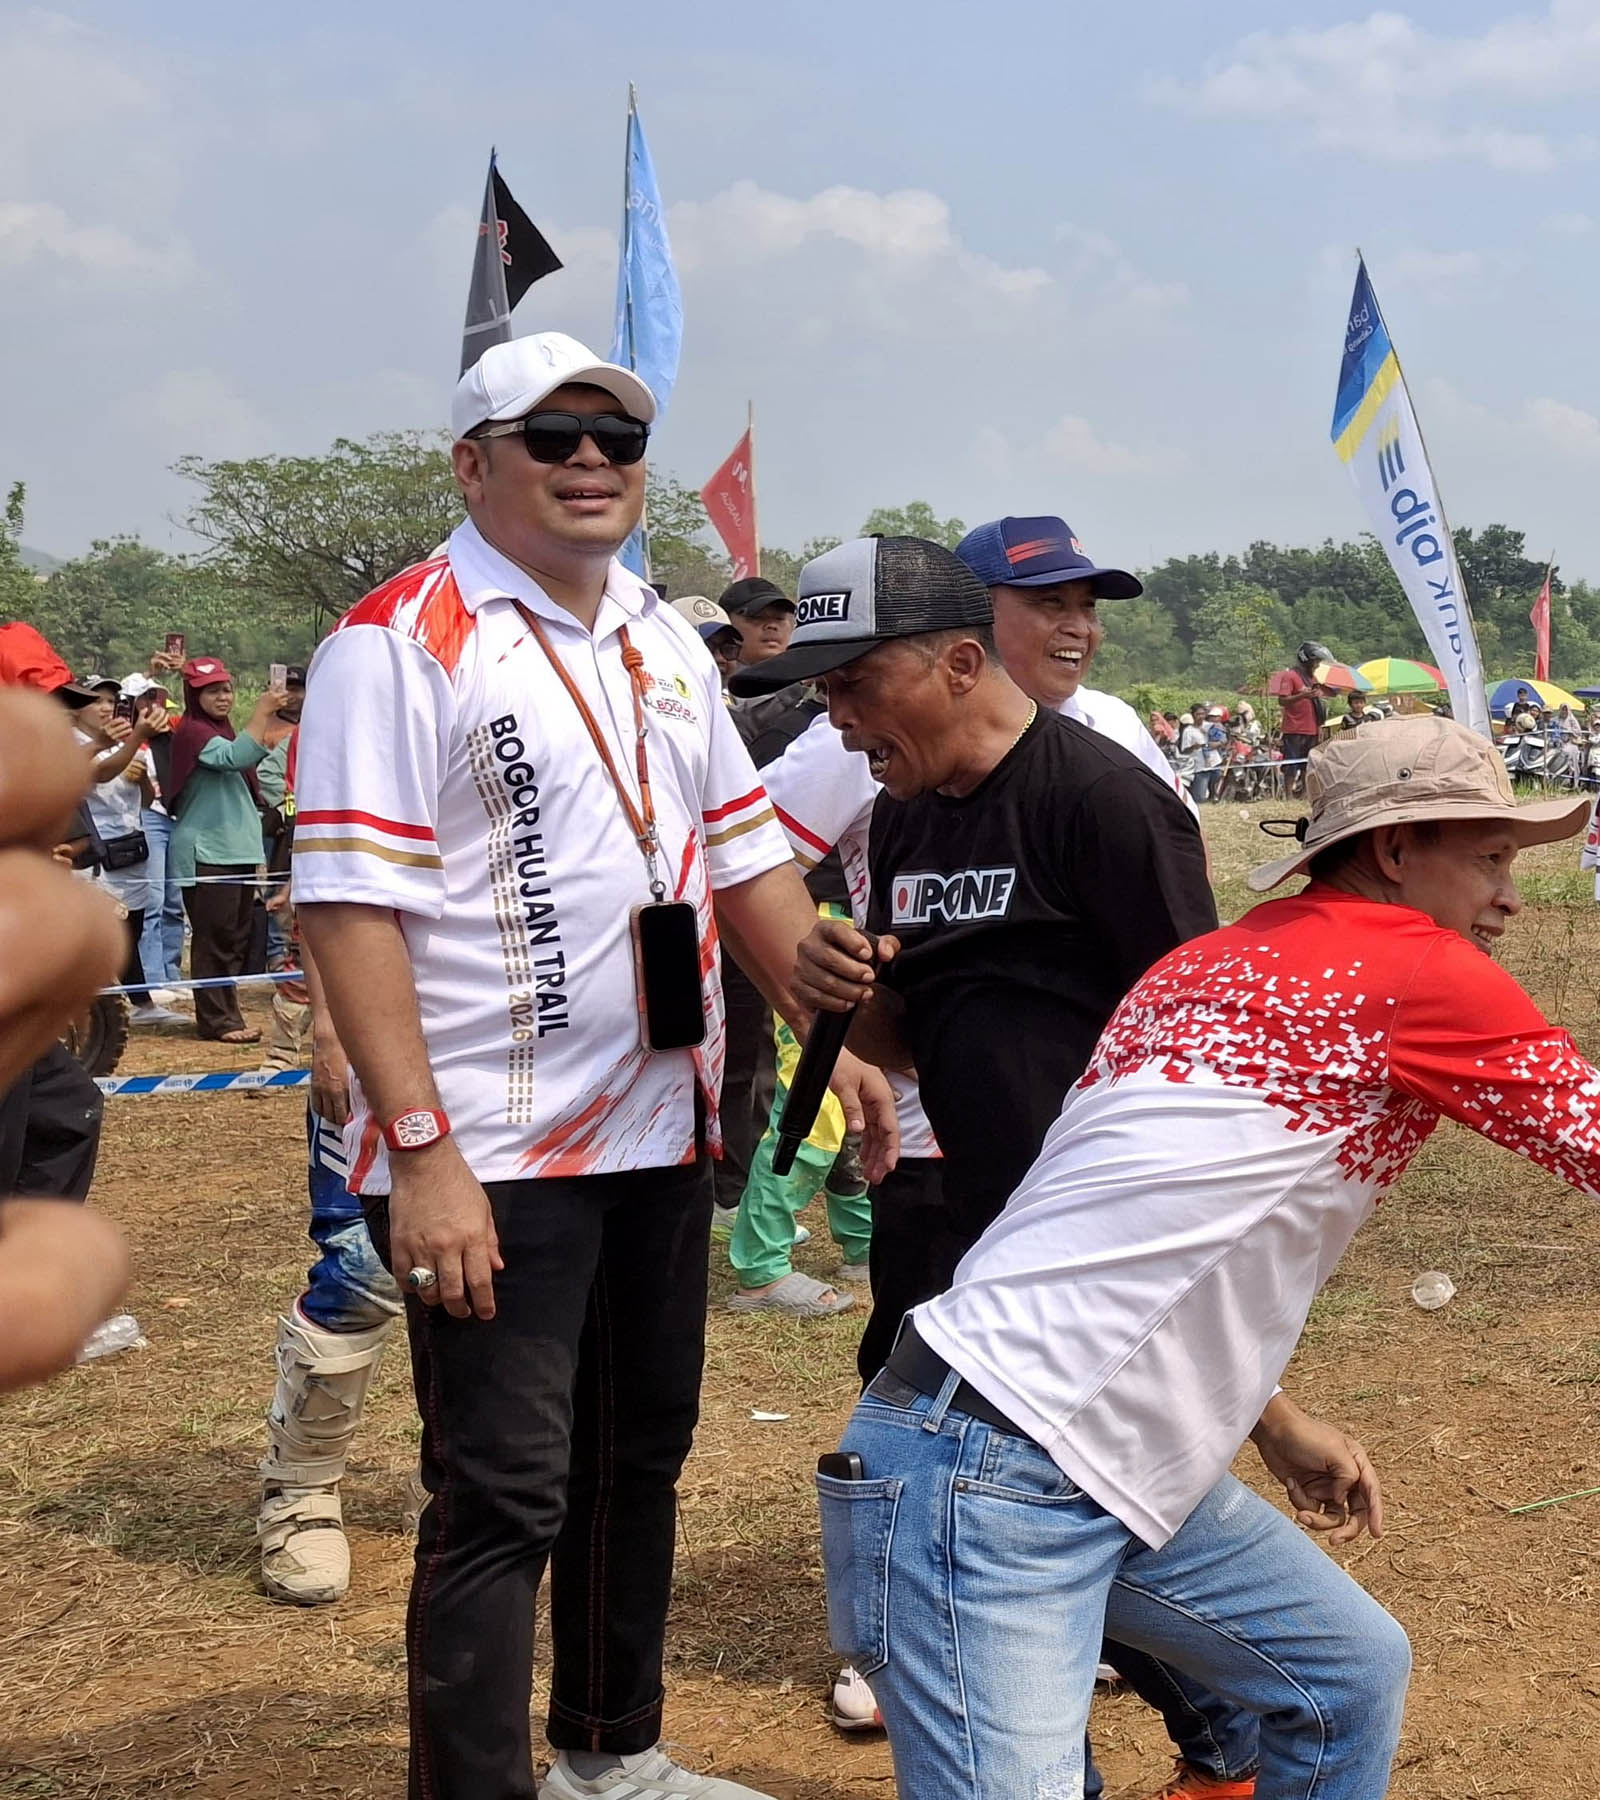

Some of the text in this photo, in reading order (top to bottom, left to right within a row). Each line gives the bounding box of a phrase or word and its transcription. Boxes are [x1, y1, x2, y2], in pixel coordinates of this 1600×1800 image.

[797, 596, 841, 621] ONE
[489, 713, 569, 1039] BOGOR HUJAN TRAIL
[912, 873, 1013, 919] IPONE
[508, 990, 535, 1042] 2026
